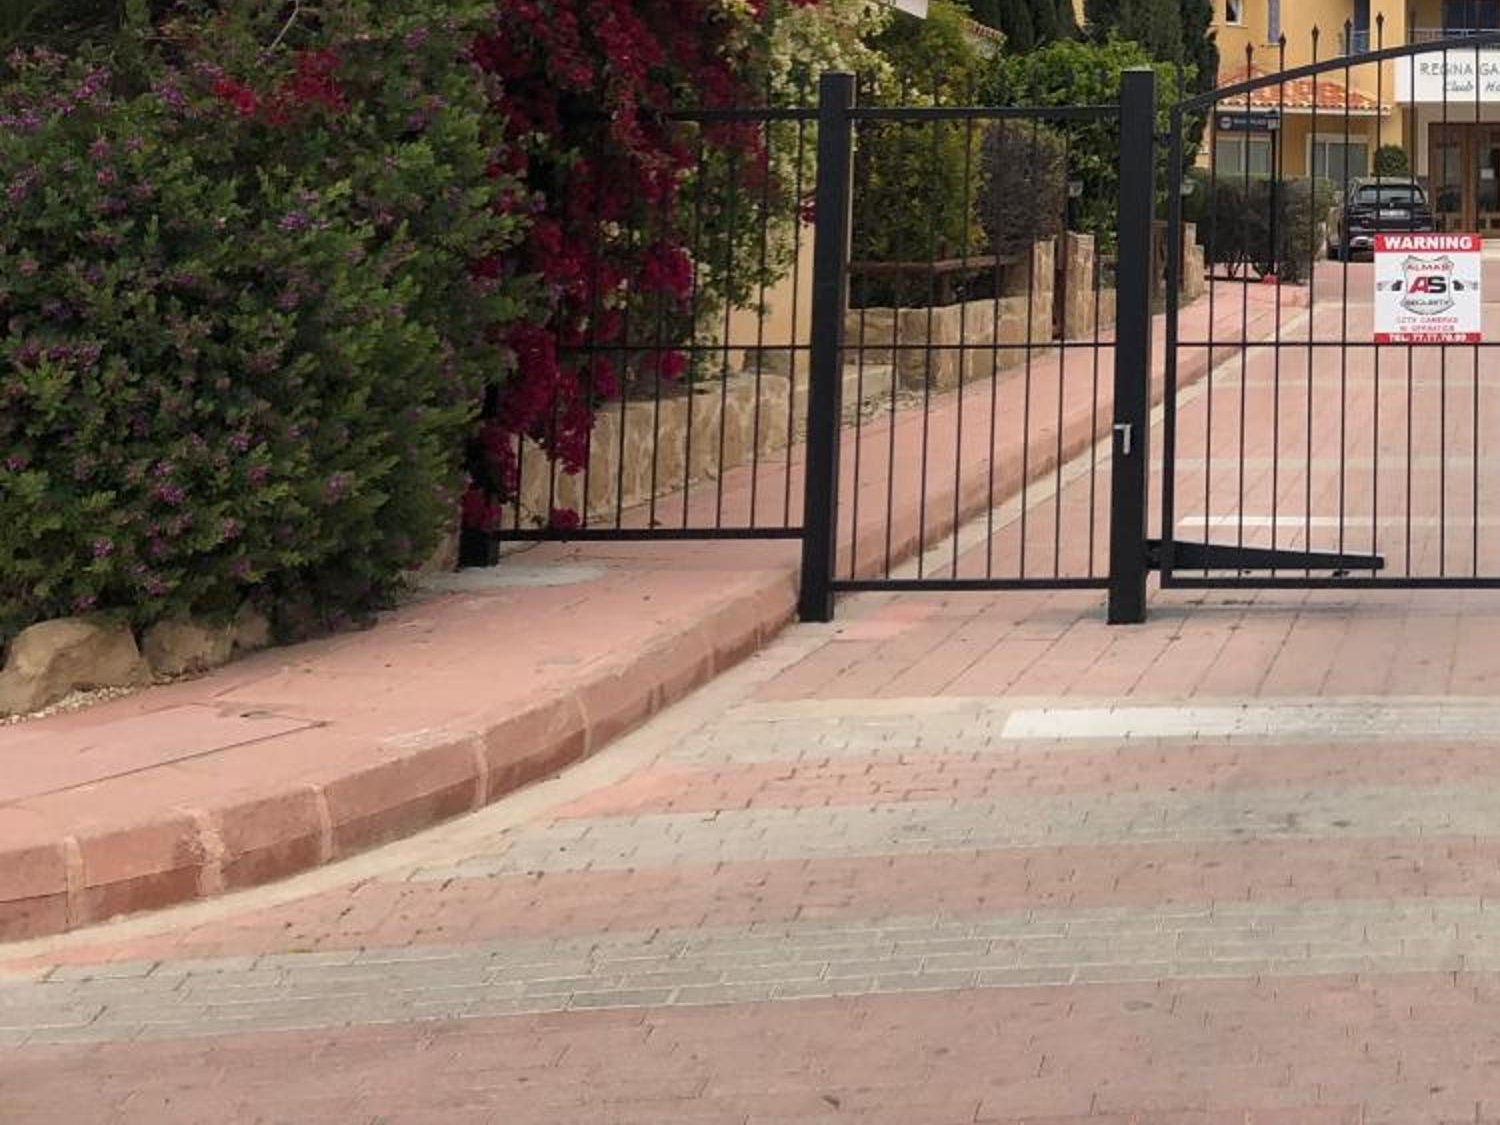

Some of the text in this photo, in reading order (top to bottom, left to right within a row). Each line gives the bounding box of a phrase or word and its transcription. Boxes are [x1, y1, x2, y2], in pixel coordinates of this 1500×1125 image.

[1420, 62, 1473, 75] REGINA
[1384, 235, 1473, 250] WARNING
[1409, 276, 1447, 294] AS
